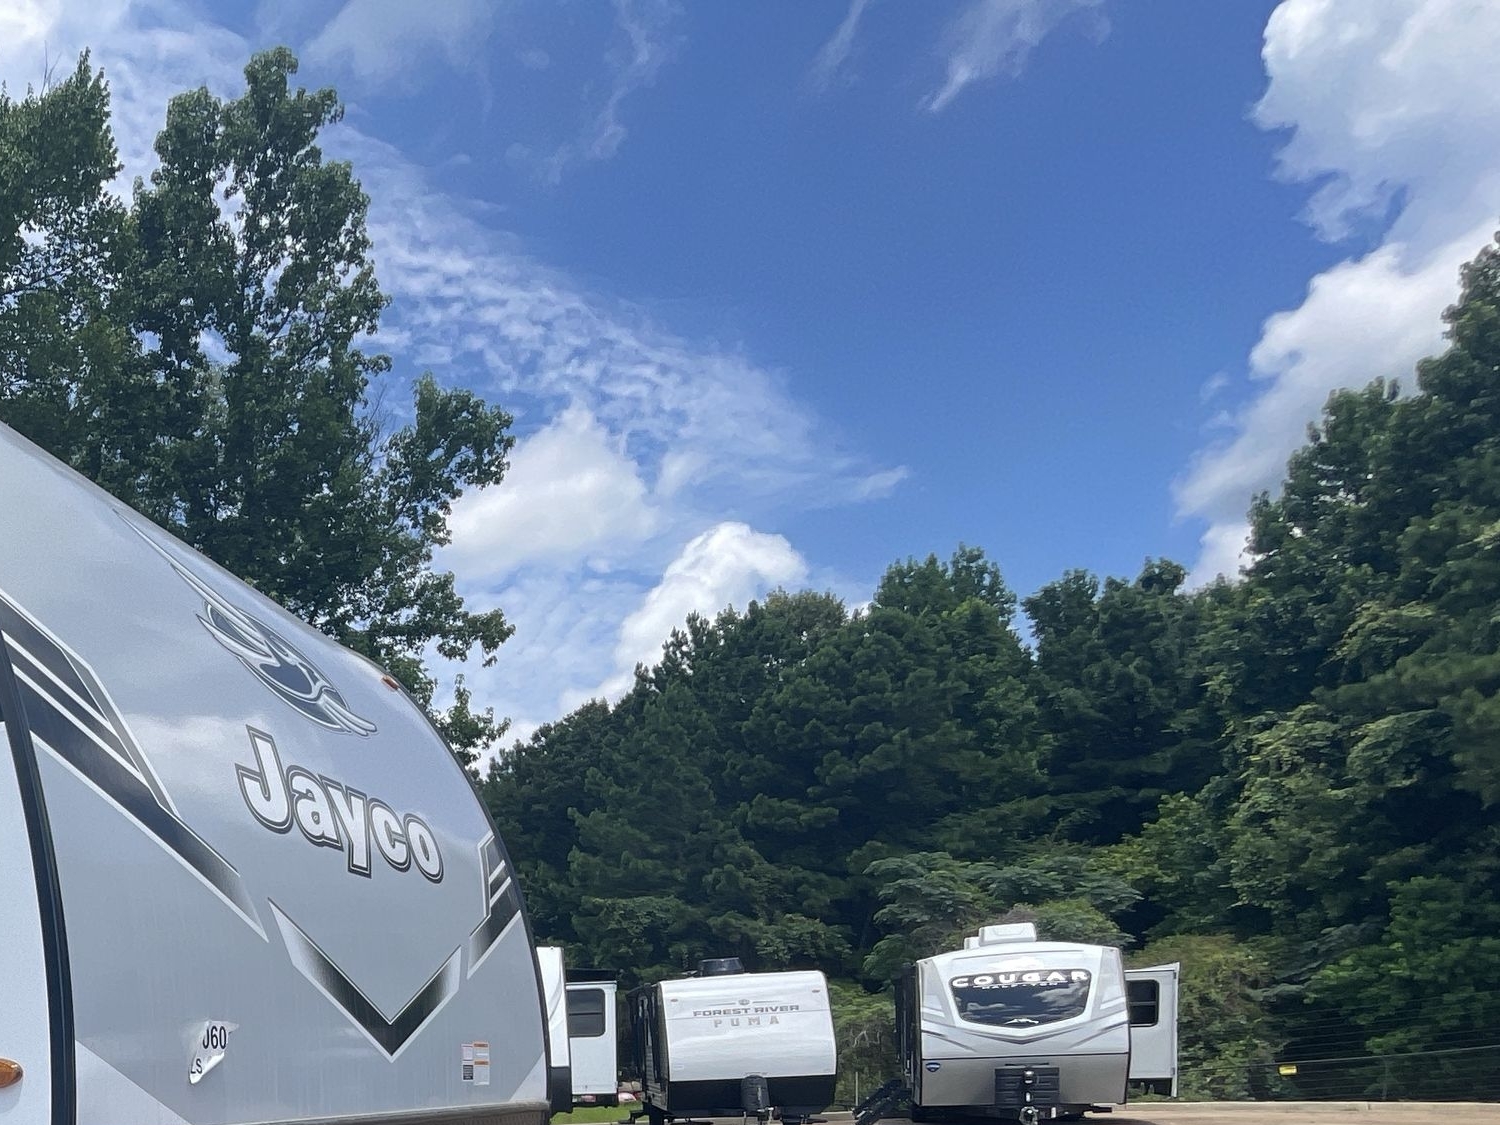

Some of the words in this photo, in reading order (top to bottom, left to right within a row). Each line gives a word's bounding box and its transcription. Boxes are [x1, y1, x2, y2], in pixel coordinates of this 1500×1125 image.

[235, 724, 444, 884] Jayco
[952, 971, 1088, 988] COUGAR
[693, 1007, 751, 1017] FOREST
[754, 1004, 800, 1013] RIVER
[713, 1016, 780, 1028] PUMA
